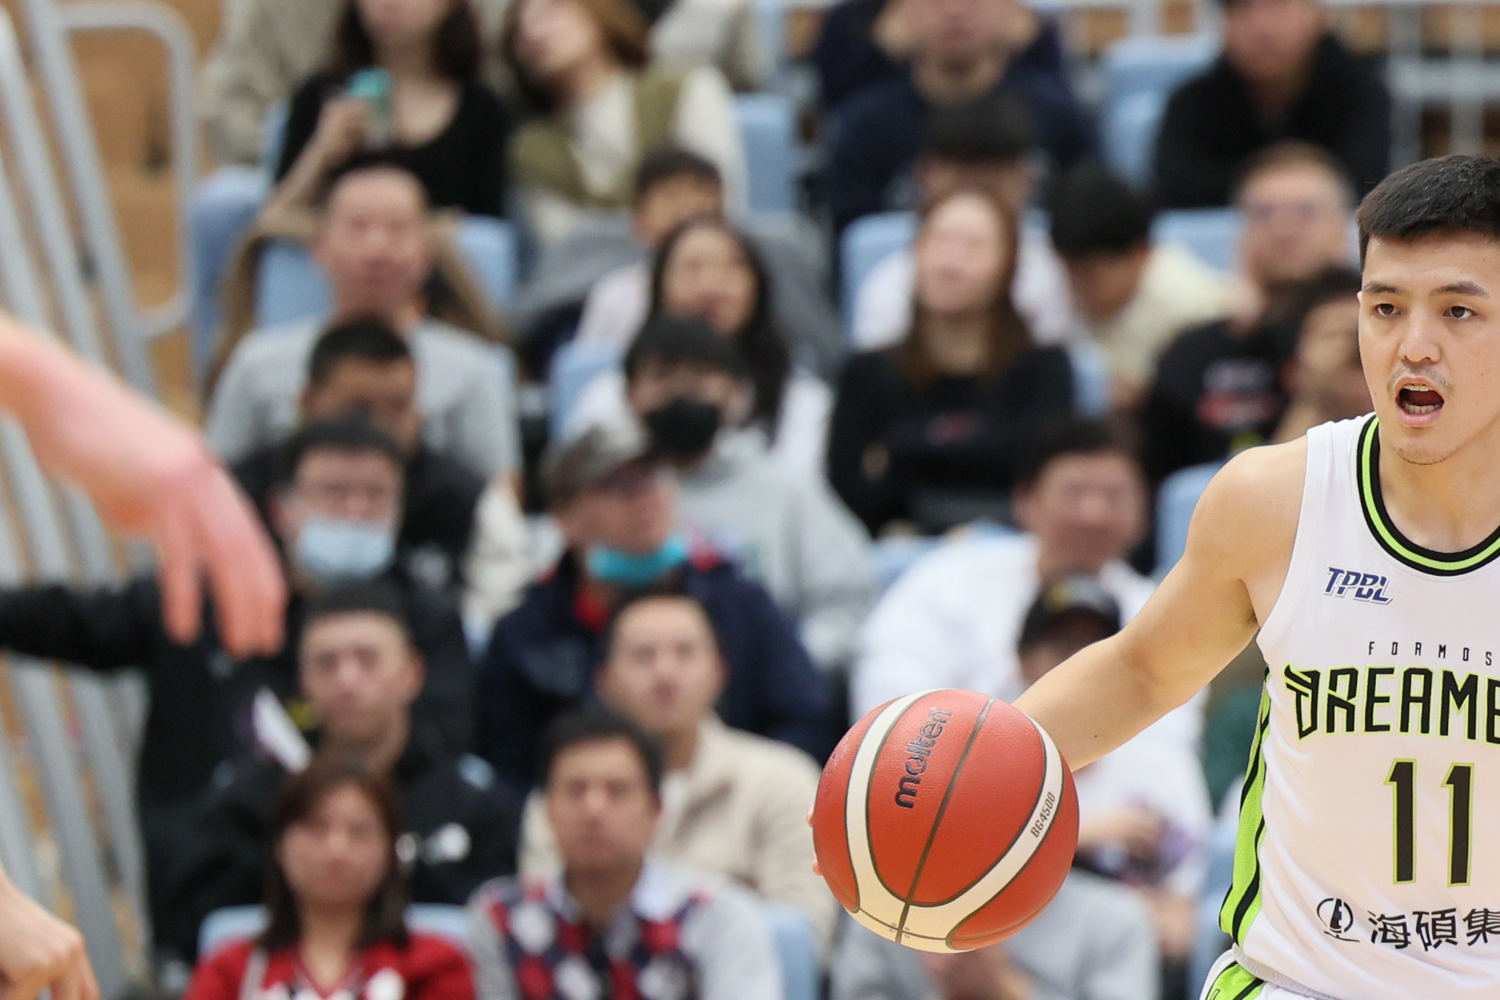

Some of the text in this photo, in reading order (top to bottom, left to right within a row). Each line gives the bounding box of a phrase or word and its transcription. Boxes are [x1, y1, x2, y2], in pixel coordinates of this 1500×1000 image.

[1324, 566, 1392, 604] TPBL
[894, 708, 952, 810] molten
[1030, 791, 1056, 839] BG4500
[1384, 758, 1475, 887] 11
